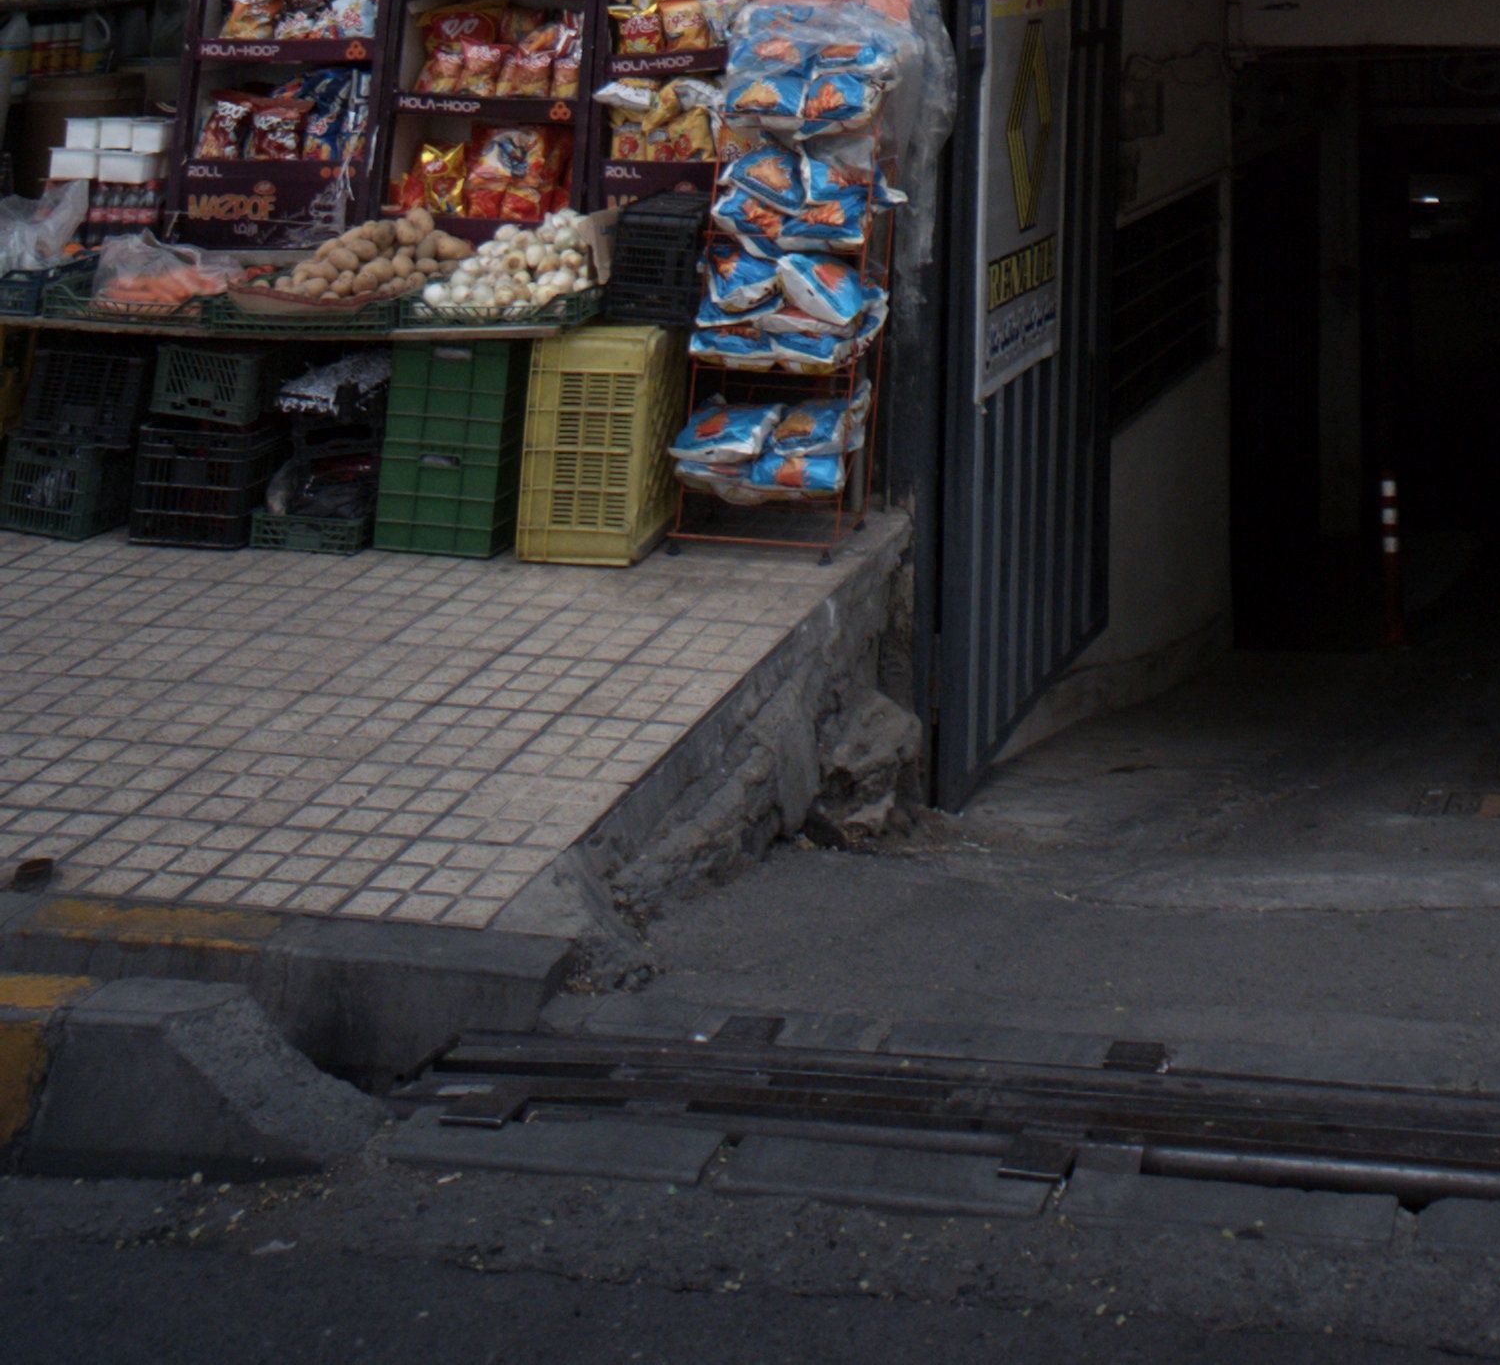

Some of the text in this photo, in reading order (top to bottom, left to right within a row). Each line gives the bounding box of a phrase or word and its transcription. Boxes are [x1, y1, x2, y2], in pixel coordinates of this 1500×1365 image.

[200, 43, 281, 57] HOLA-HOOP
[611, 55, 694, 73] HOLA-HOOP
[399, 96, 482, 112] HOLA-HOOP
[187, 166, 222, 178] ROLL
[604, 165, 642, 179] ROLL
